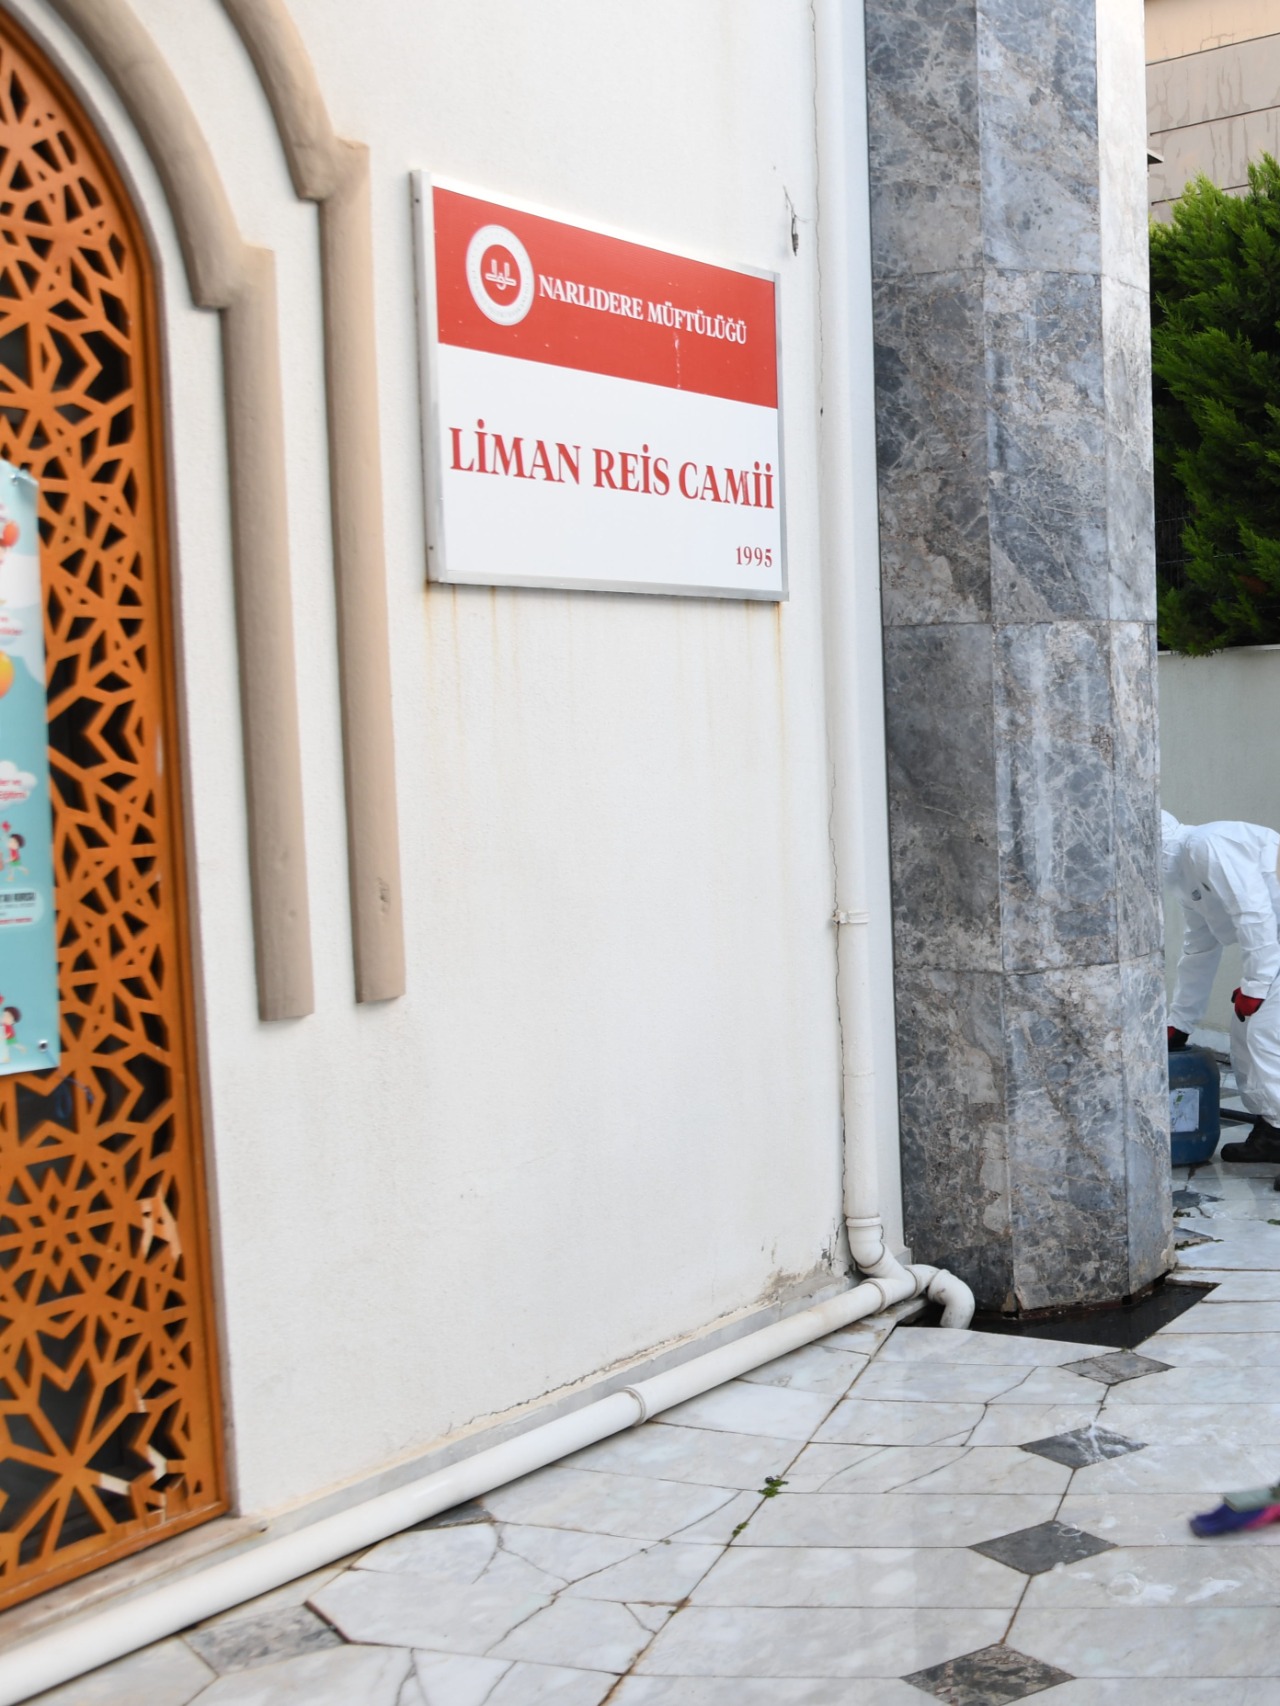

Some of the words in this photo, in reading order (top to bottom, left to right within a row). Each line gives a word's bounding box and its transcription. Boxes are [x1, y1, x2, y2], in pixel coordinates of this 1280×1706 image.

[538, 274, 644, 321] NARLIDERE
[647, 301, 747, 345] MÜFTÜLÜĞÜ
[448, 418, 581, 485] LİMAN
[592, 444, 670, 496] REİS
[678, 461, 774, 509] CAMİİ
[735, 546, 772, 568] 1995
